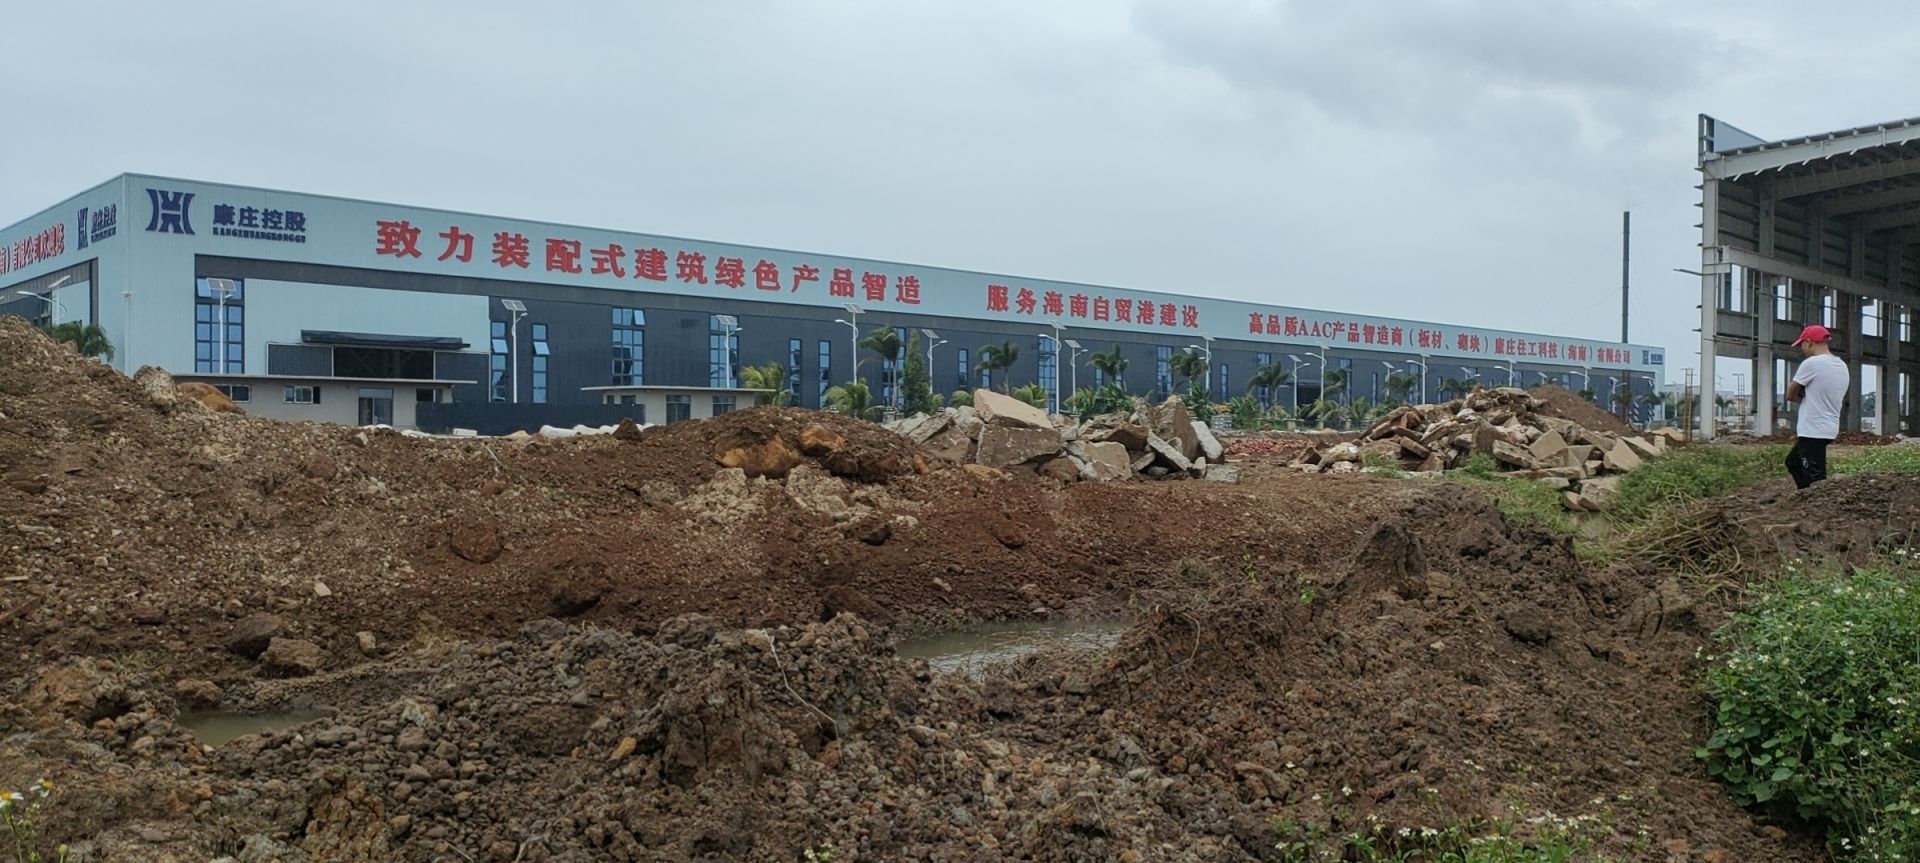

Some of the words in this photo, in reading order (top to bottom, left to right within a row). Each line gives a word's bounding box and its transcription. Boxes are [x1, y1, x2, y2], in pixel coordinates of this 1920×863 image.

[213, 203, 306, 232] 康庄控股
[376, 220, 921, 305] 致力装配式建筑绿色产品智造
[987, 284, 1199, 329] 服务海南自贸港建设
